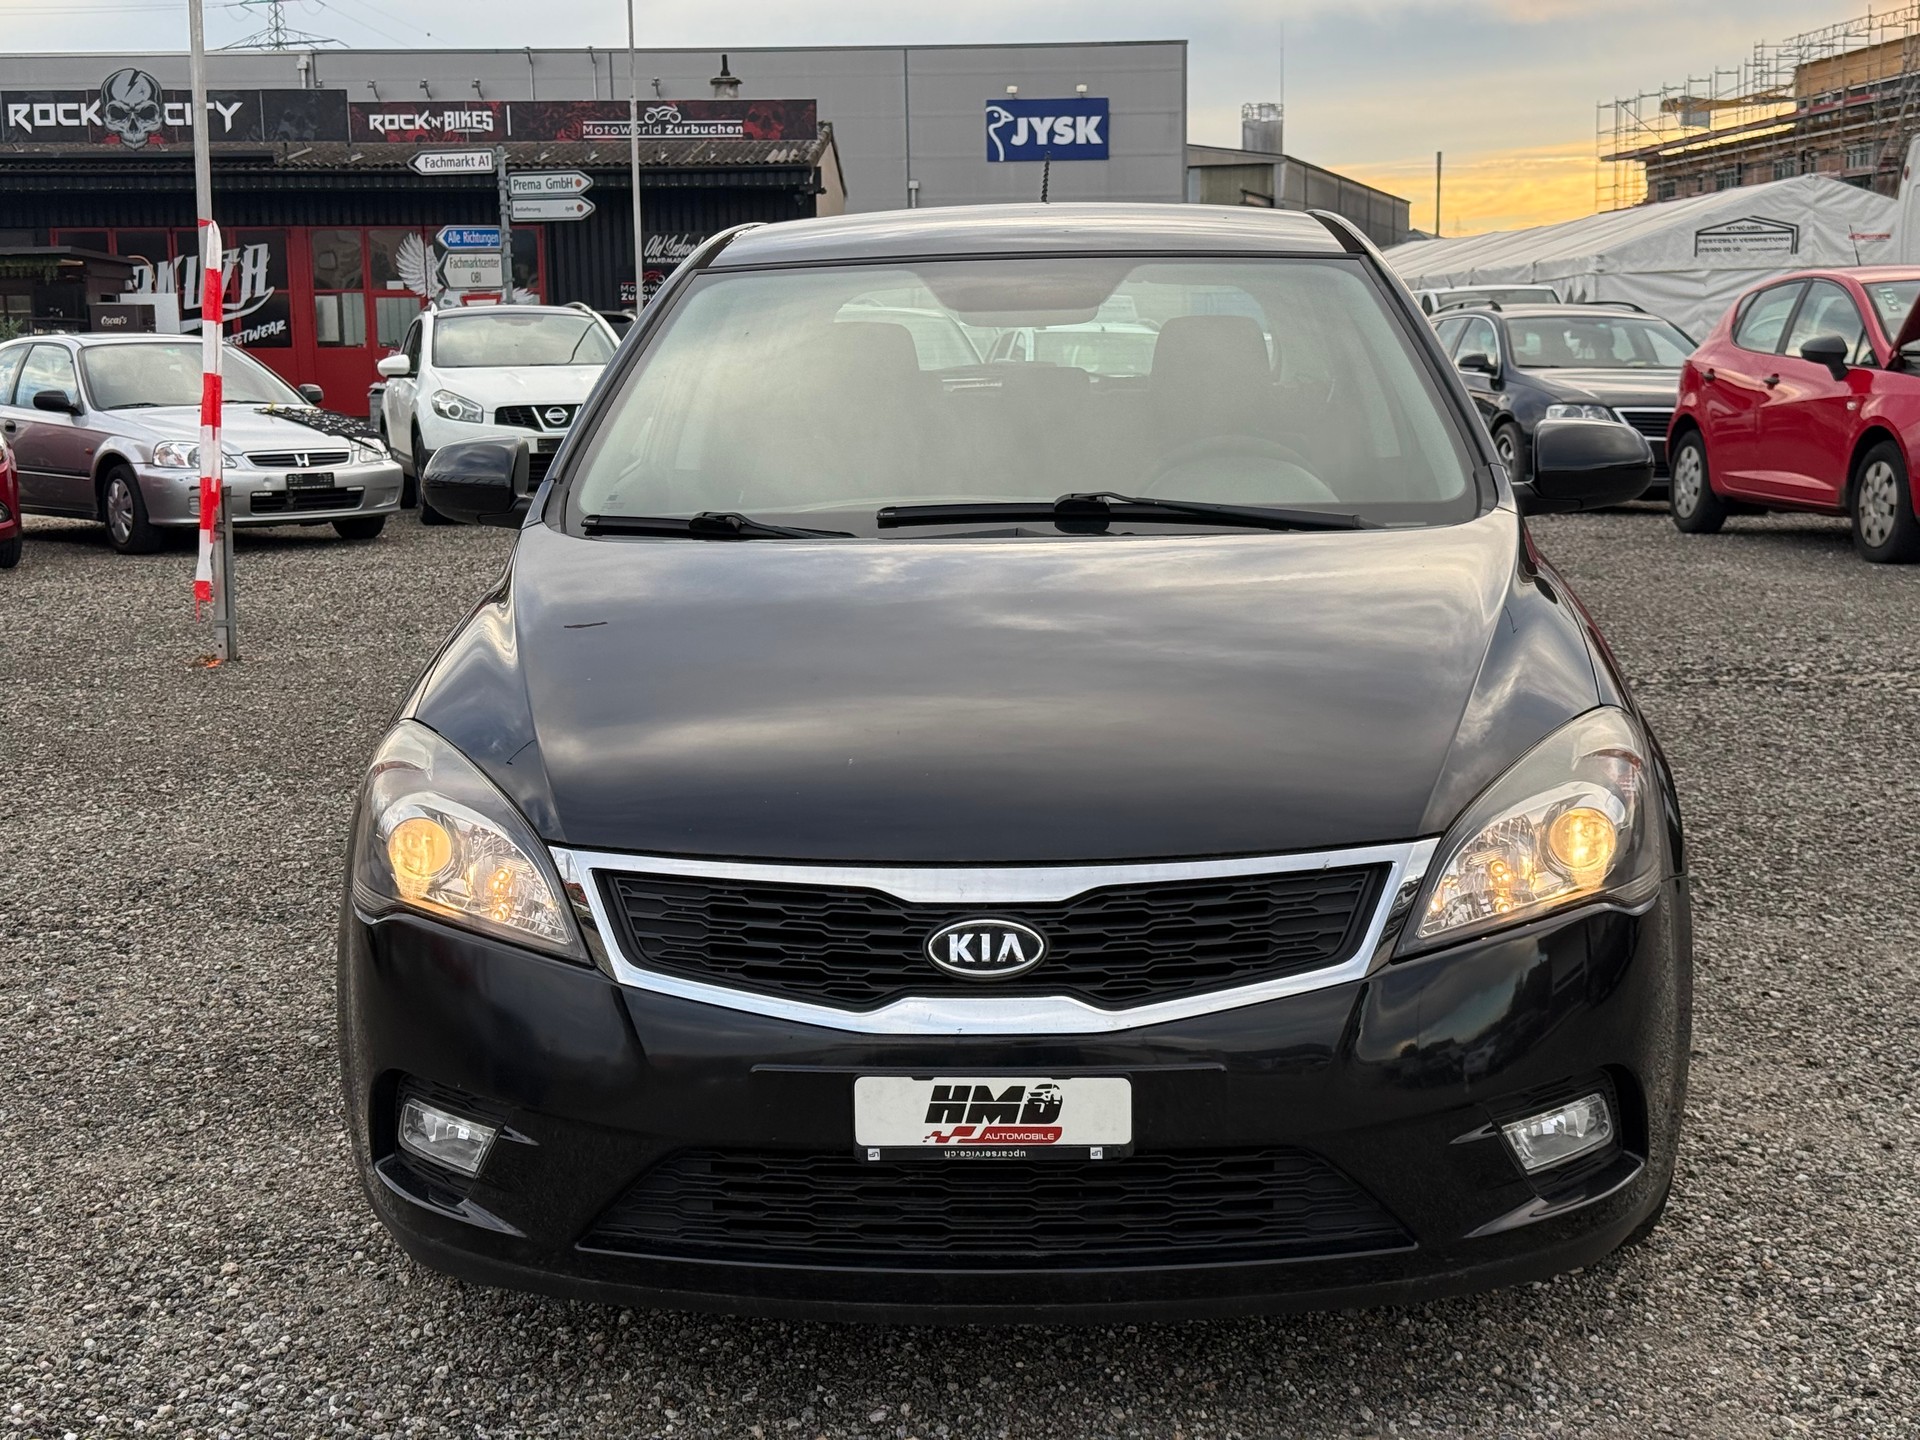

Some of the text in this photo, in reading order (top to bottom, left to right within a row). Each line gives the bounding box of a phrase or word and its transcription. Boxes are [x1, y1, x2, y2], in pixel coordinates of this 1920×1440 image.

[8, 99, 103, 134] ROCK
[583, 124, 743, 135] MotoWorld Zurbuchen
[1010, 116, 1103, 146] JYSK
[425, 155, 490, 169] Fachmarkt A1
[513, 178, 573, 191] Prema GmbH
[448, 231, 499, 246] Alle Richtungen
[644, 234, 668, 257] Old
[449, 257, 499, 283] Fachmarktcenter OBI
[948, 933, 1026, 963] KIA
[925, 1084, 1063, 1124] HMD
[984, 1132, 1055, 1141] AUTOMOBILE
[944, 1150, 1026, 1158] upcarservice.ch
